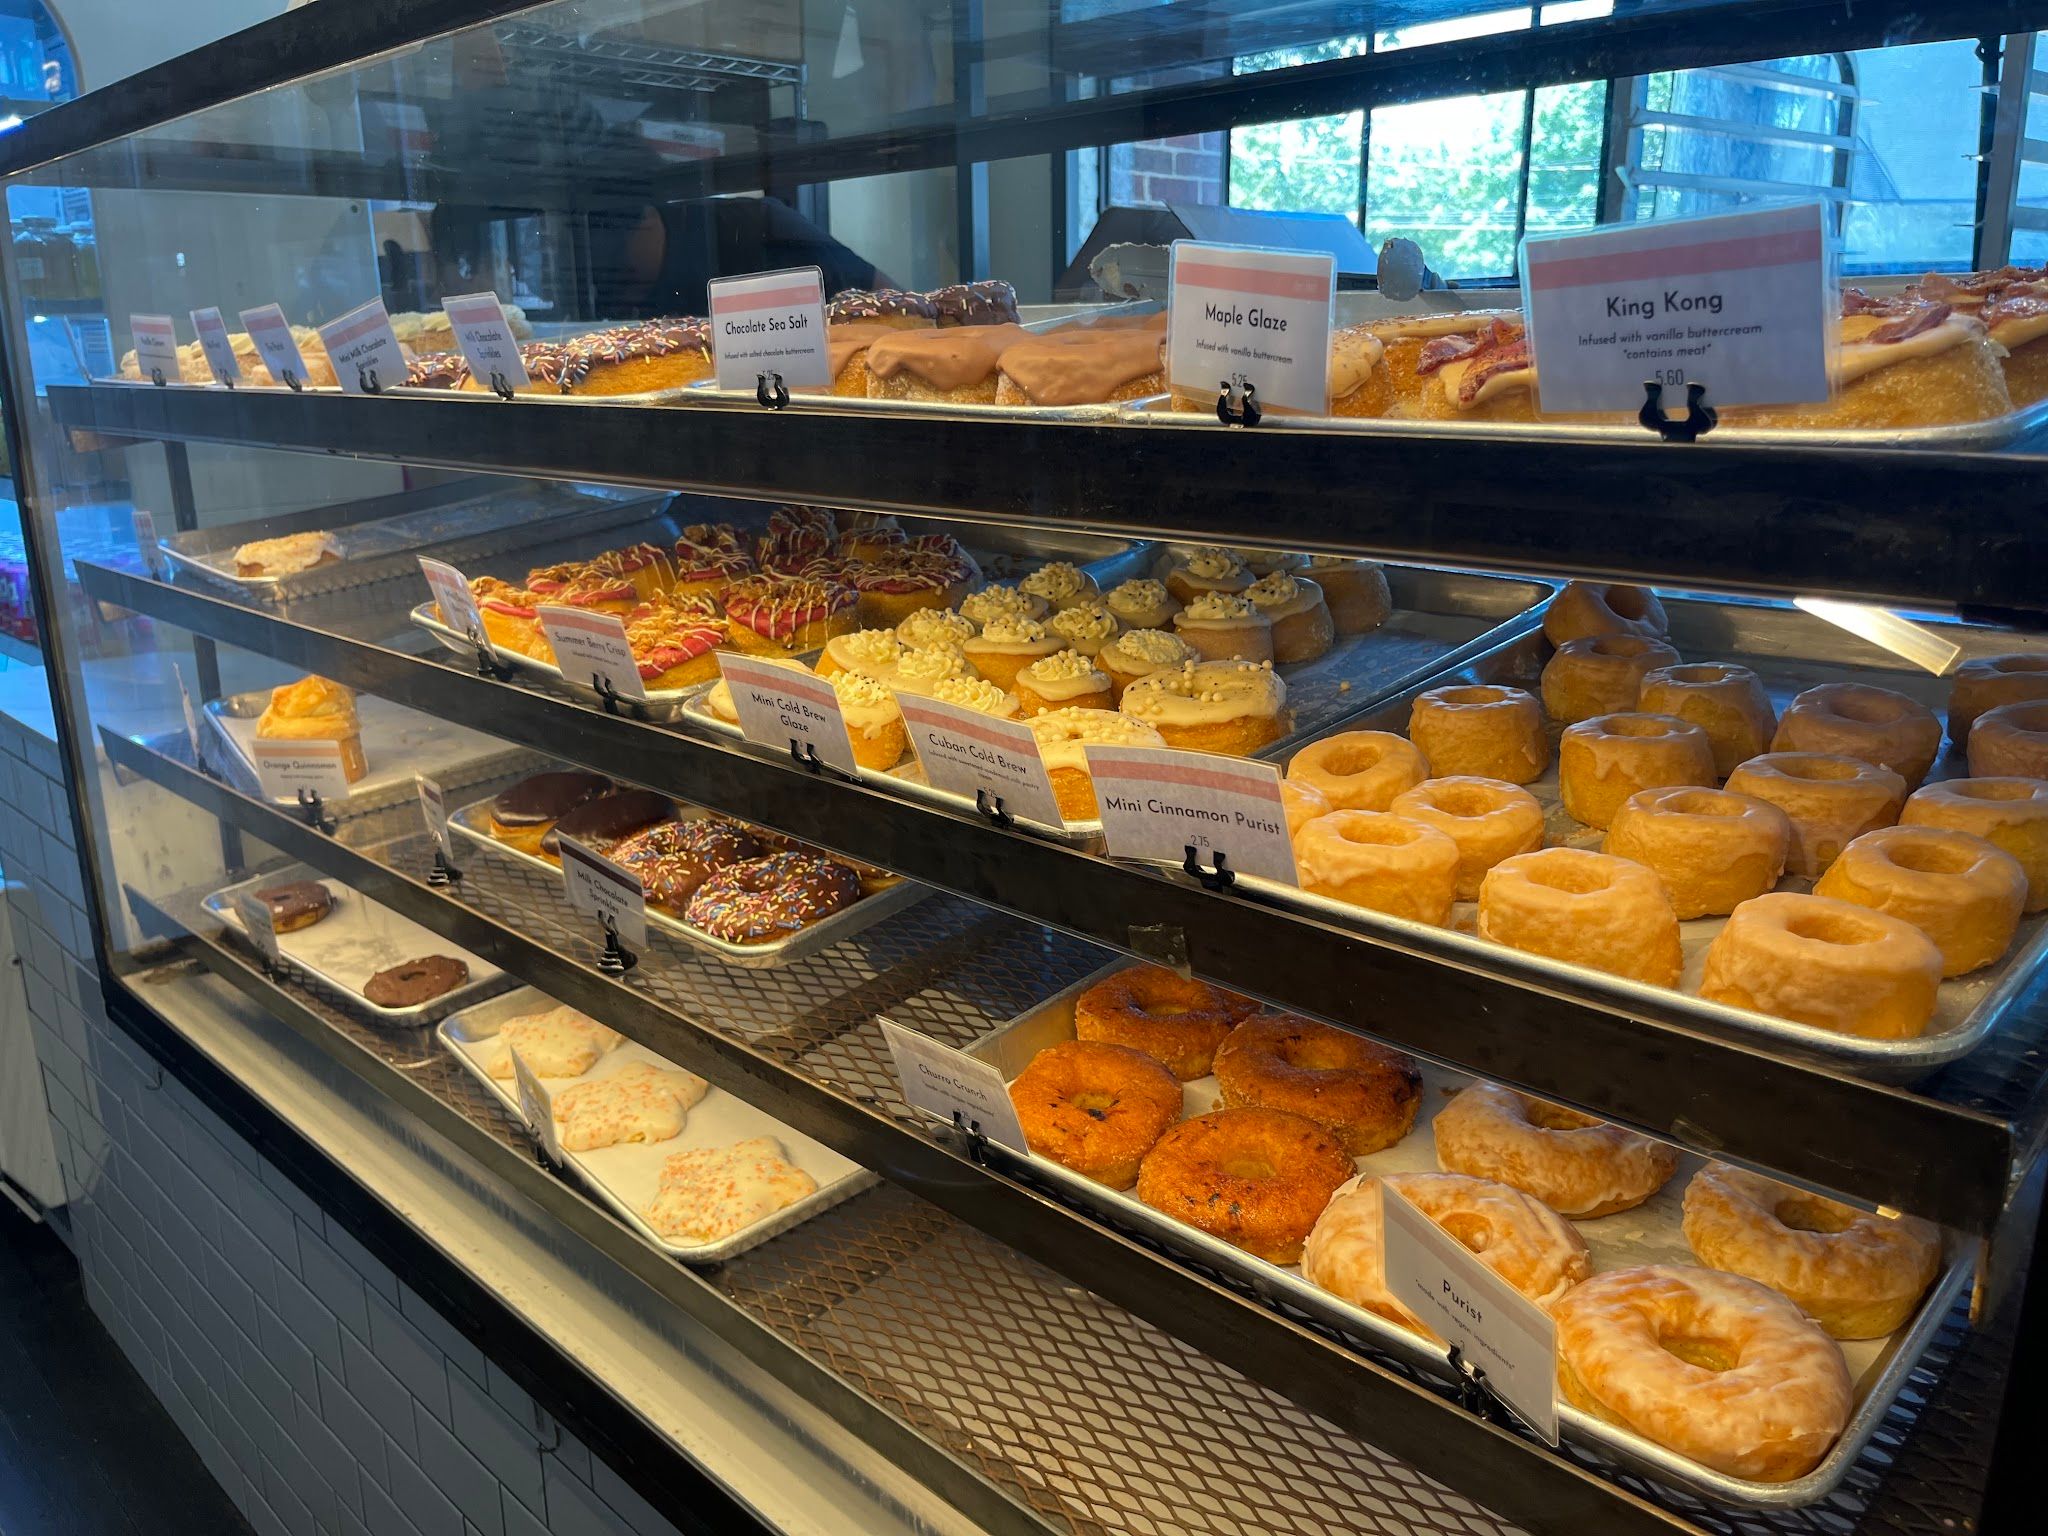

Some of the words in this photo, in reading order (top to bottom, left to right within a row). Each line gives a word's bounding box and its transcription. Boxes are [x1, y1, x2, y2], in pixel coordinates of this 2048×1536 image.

[1205, 302, 1242, 328] Maple
[1248, 308, 1287, 331] Glaze
[1607, 296, 1655, 319] King
[1664, 290, 1723, 314] Kong
[725, 319, 766, 335] Chocolate
[769, 318, 786, 331] Sea
[789, 314, 808, 329] Salt
[1578, 333, 1616, 347] Infused
[1619, 330, 1642, 344] with
[1645, 327, 1684, 341] vanilla
[1687, 323, 1762, 340] buttercream
[361, 338, 387, 353] Chocolate
[763, 348, 784, 357] chocolate
[785, 347, 815, 356] buttercream
[1195, 339, 1216, 351] Infused
[1217, 343, 1229, 354] with
[1230, 345, 1251, 358] vanilla
[1253, 349, 1293, 364] buttercream
[1655, 369, 1684, 386] 5.60
[554, 631, 585, 647] Summer
[586, 637, 605, 652] Berry
[606, 642, 626, 658] Crisp
[751, 692, 775, 708] Mini
[777, 698, 800, 715] Cold
[803, 705, 826, 723] Brew
[780, 714, 810, 733] Glaze
[929, 733, 967, 755] Cuban
[969, 745, 995, 764] Cold
[997, 755, 1027, 775] Brew
[1105, 796, 1142, 813] Mini
[1147, 799, 1230, 824] Cinnamon
[1235, 811, 1280, 835] Purist
[577, 870, 592, 884] Milk
[593, 879, 628, 907] Chocolate
[589, 888, 620, 915] Sprinkles
[918, 1063, 951, 1085] Churro
[952, 1078, 988, 1102] Crunch
[1443, 1278, 1482, 1323] Purist
[1437, 1301, 1450, 1315] with
[1451, 1315, 1472, 1335] vegan
